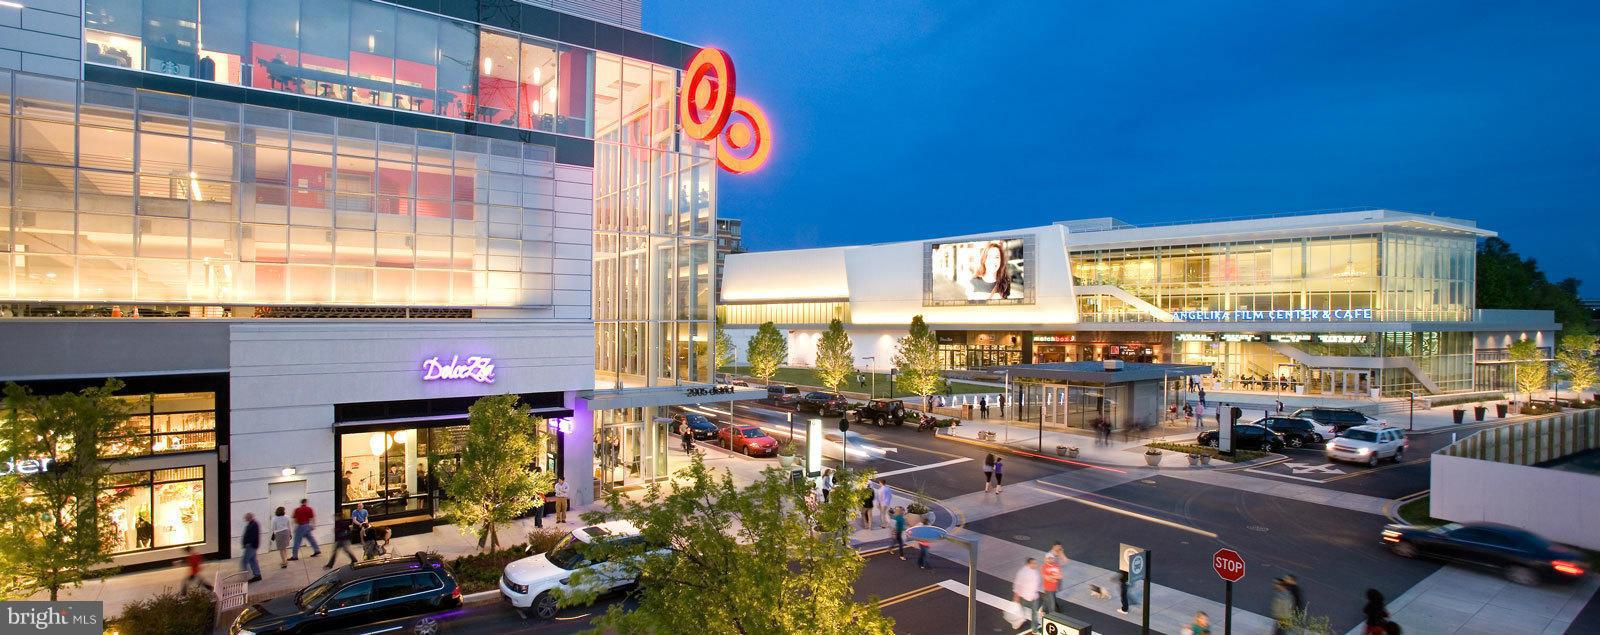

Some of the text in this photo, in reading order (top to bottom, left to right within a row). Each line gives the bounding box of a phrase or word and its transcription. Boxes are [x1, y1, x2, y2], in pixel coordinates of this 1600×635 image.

[1173, 310, 1229, 320] ANGELIKA
[1235, 310, 1264, 320] FILM
[1268, 309, 1318, 320] CENTER
[1322, 309, 1330, 319] &
[709, 386, 734, 395] district
[1215, 556, 1243, 573] STOP
